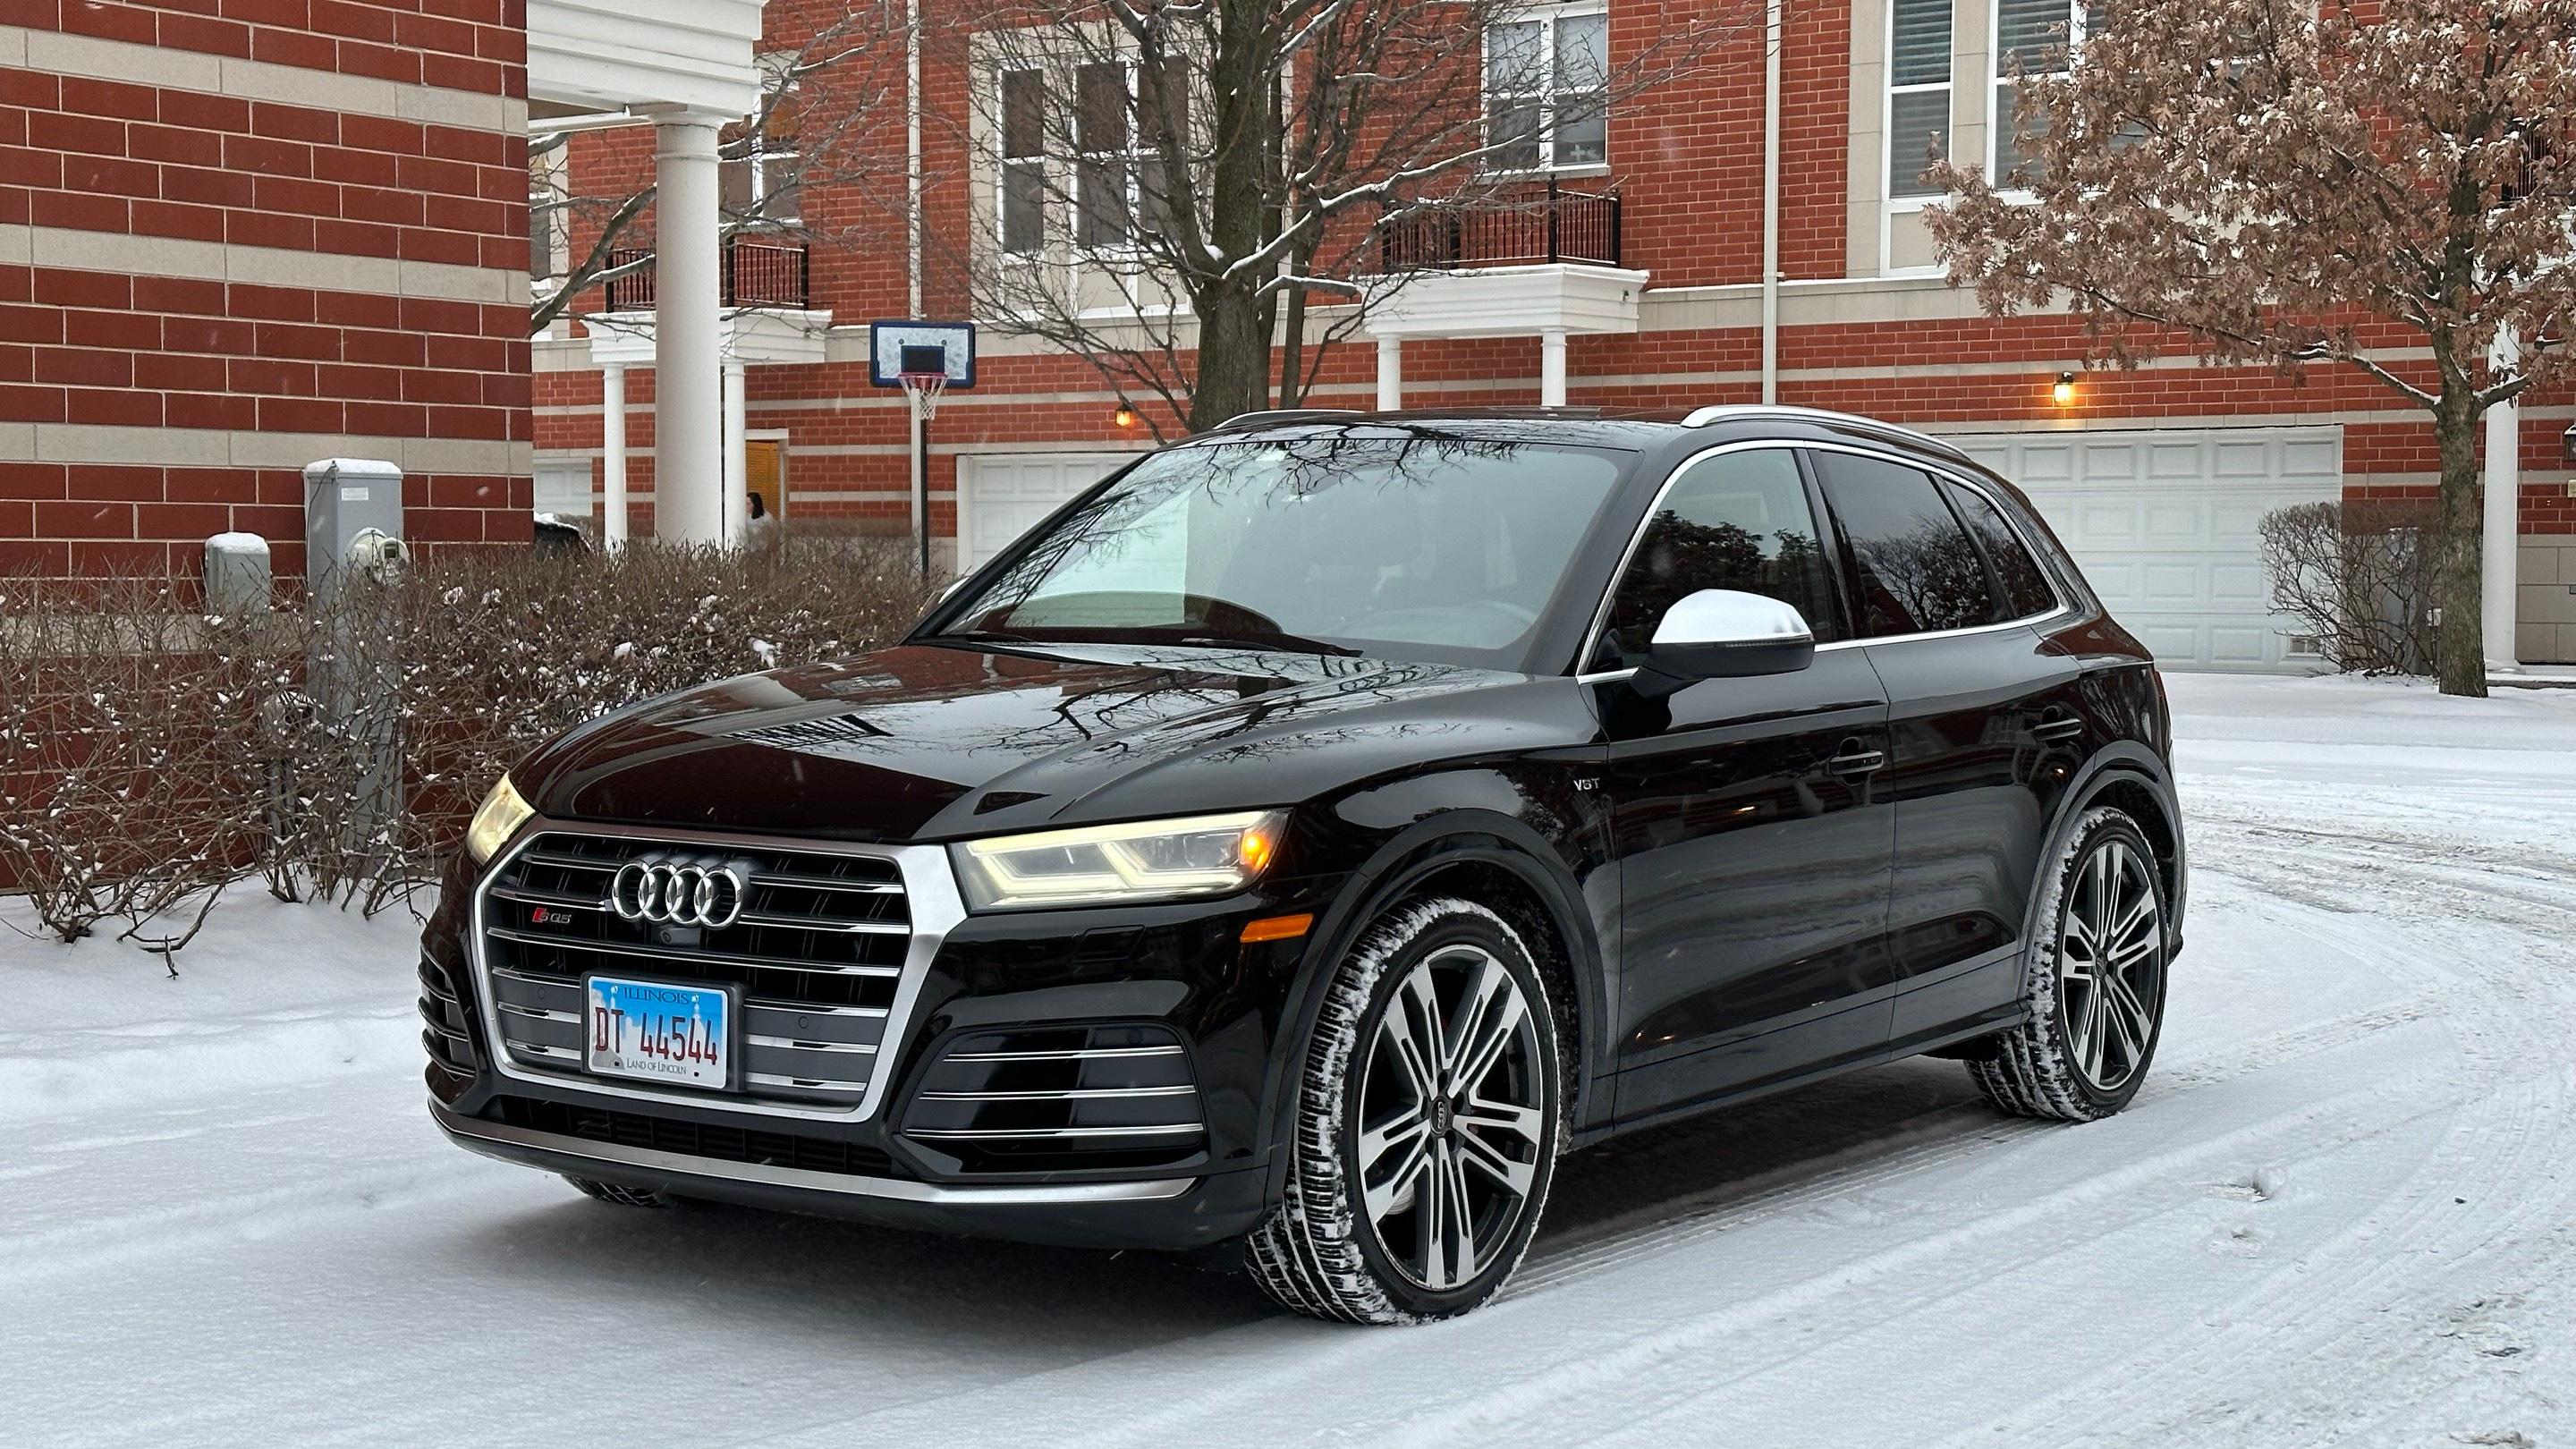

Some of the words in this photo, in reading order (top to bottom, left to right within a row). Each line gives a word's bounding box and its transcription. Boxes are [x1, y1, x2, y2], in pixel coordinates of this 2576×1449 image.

[623, 987, 691, 1005] ILLINOIS
[595, 1006, 624, 1054] DT
[640, 1012, 717, 1066] 44544
